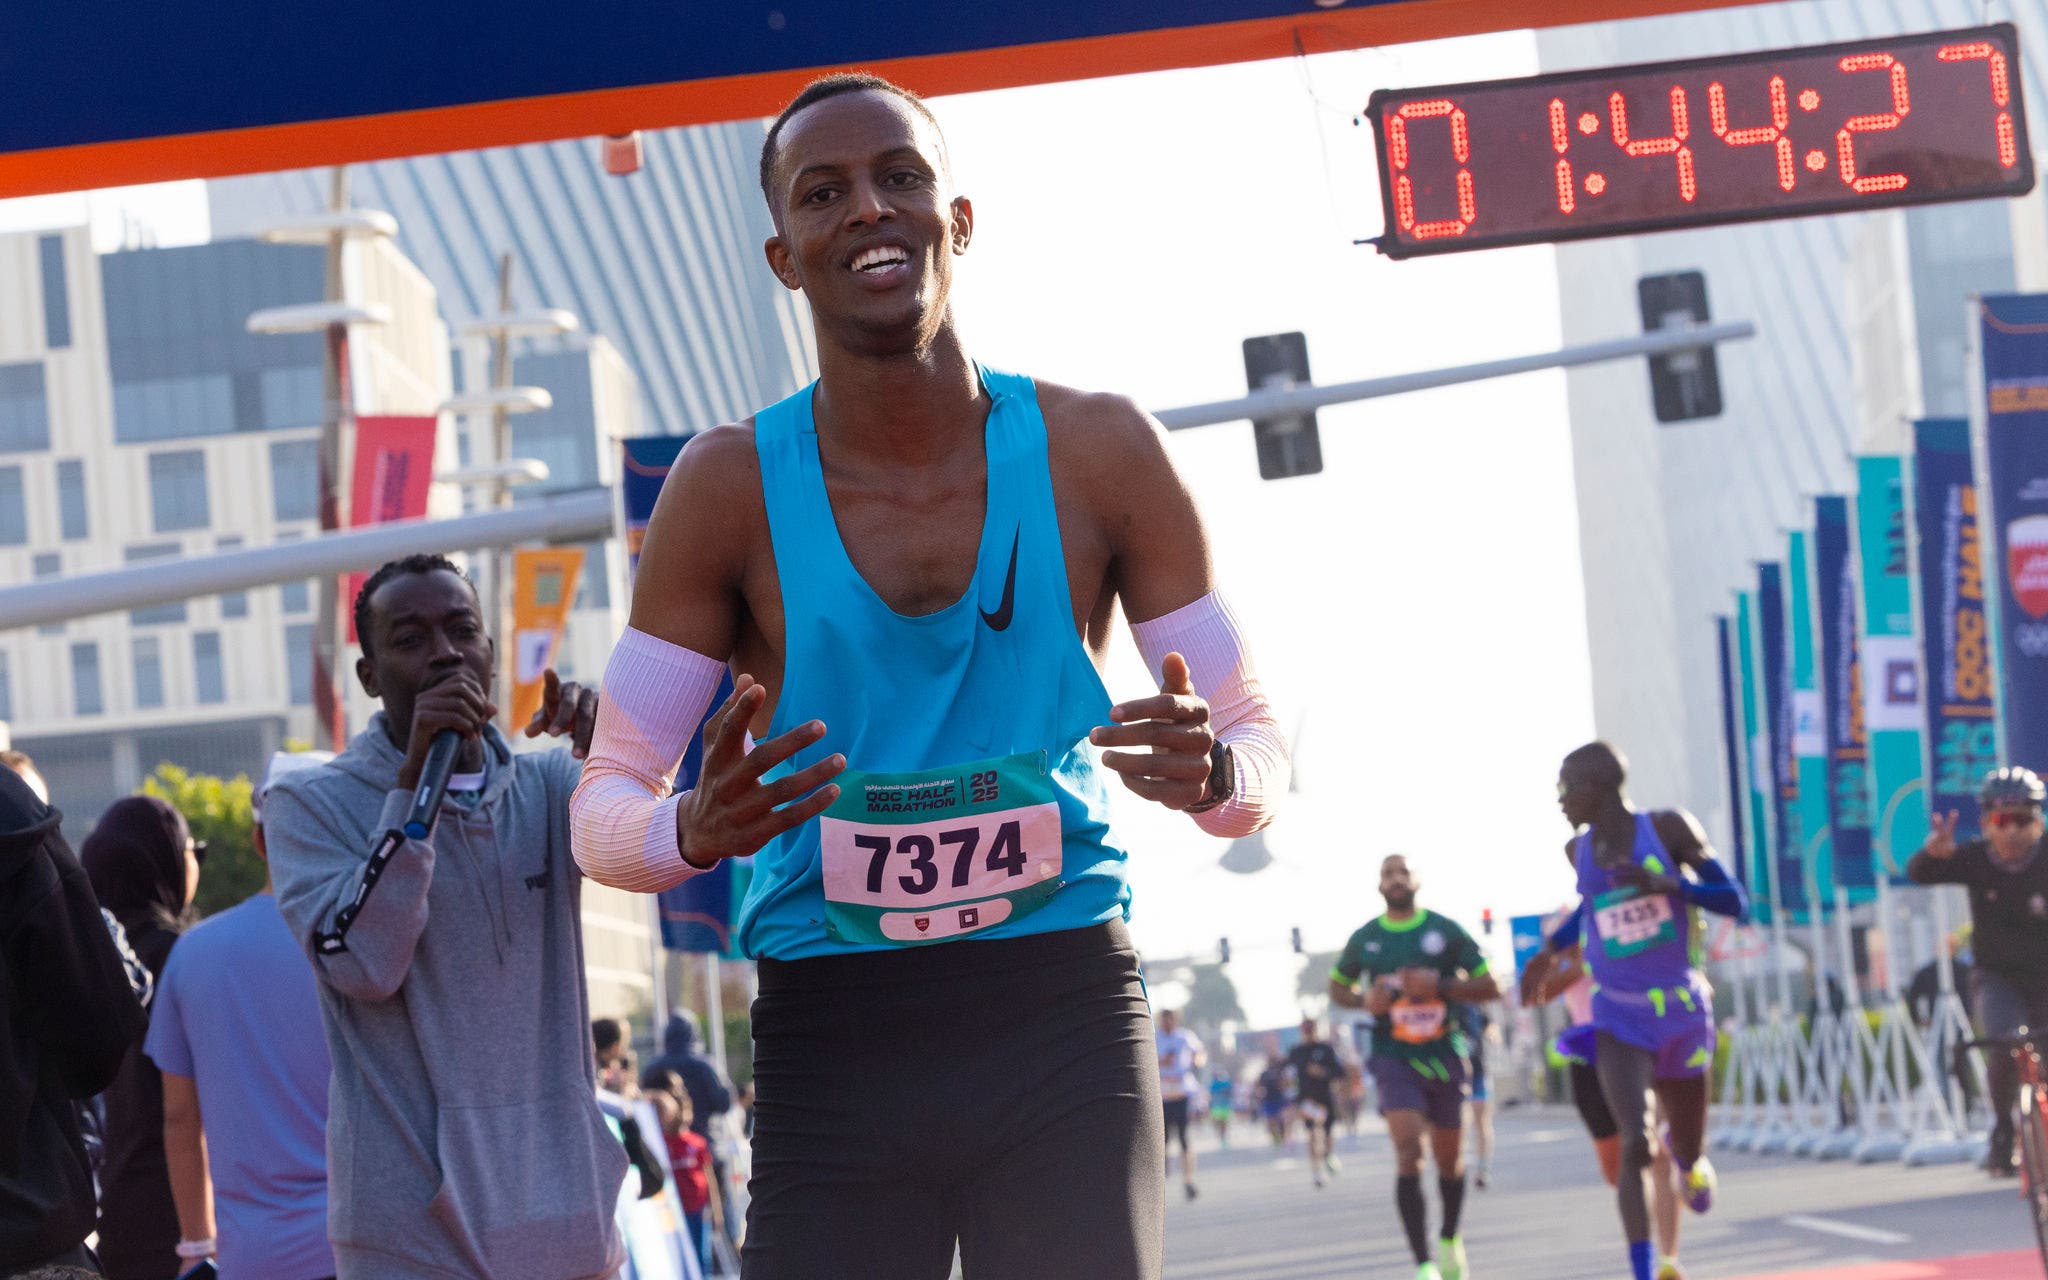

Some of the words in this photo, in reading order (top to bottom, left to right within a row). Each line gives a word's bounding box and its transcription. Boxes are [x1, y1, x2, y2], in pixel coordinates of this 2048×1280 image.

[970, 770, 998, 788] 20
[866, 791, 903, 803] QOC
[907, 786, 955, 802] HALF
[970, 786, 999, 804] 25
[867, 798, 956, 813] MARATHON
[854, 820, 1028, 895] 7374
